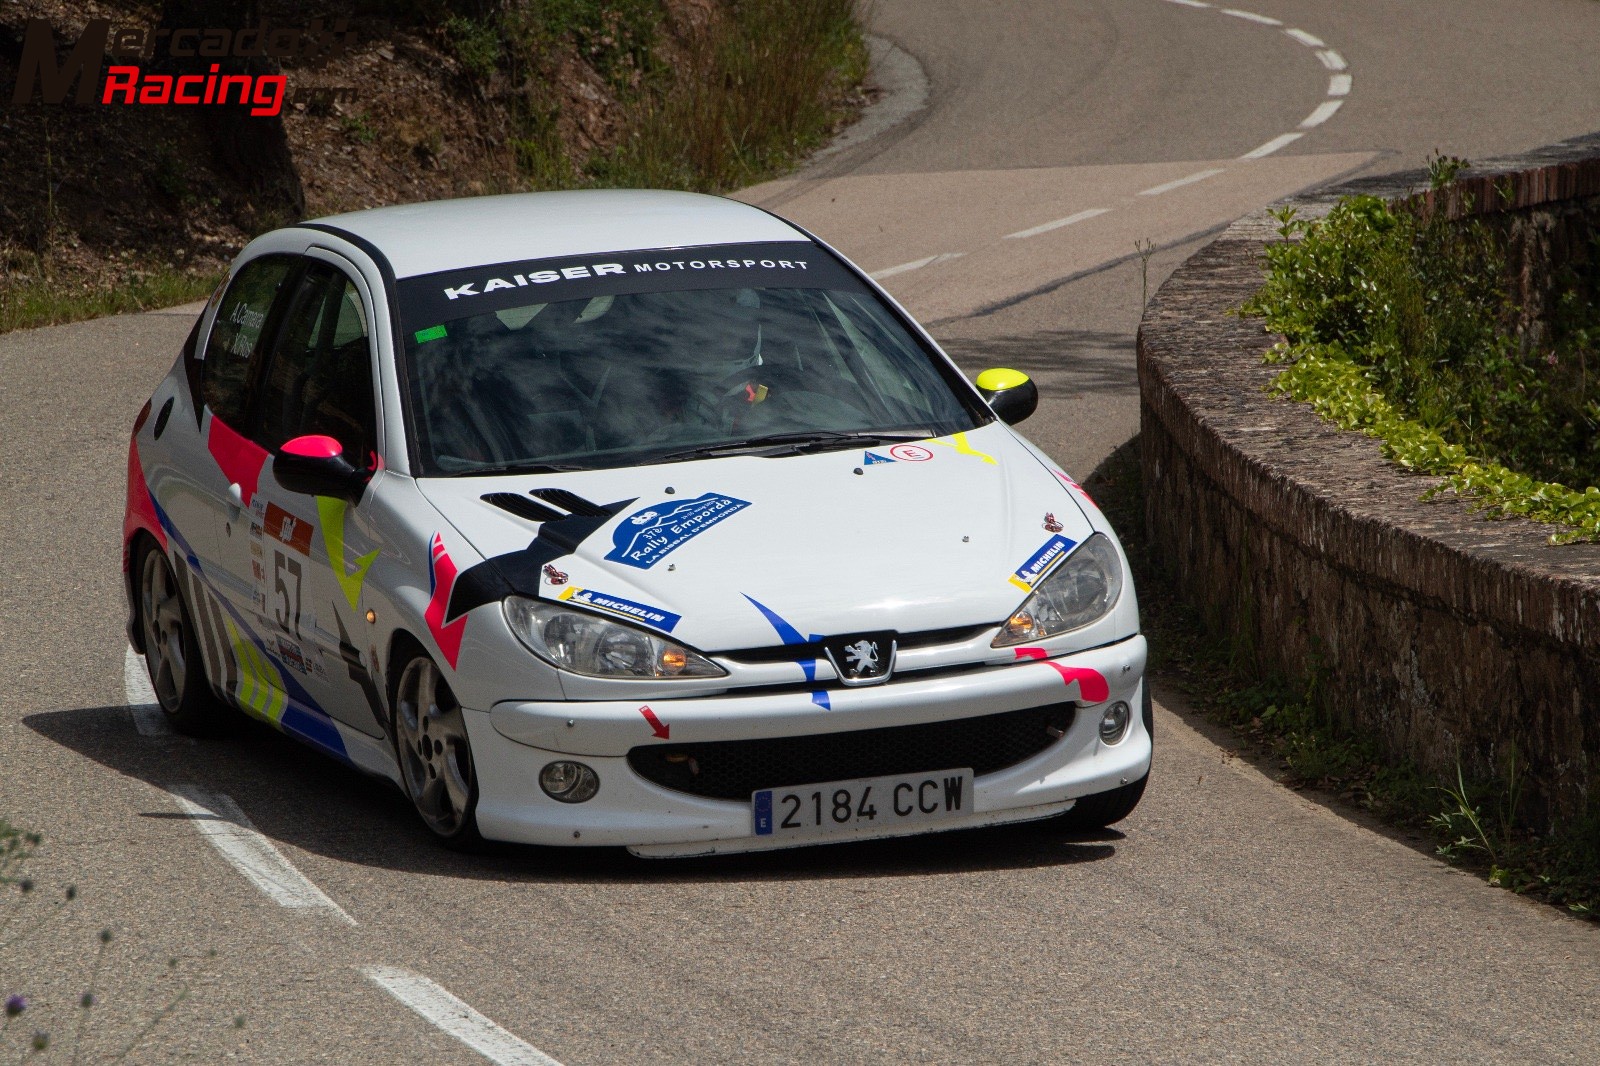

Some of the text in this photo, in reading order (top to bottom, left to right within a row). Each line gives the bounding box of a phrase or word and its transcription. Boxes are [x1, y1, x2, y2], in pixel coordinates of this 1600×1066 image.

[443, 259, 809, 300] KAISER MOTORSPORT
[630, 535, 668, 561] Rally
[645, 554, 660, 564] LA
[658, 533, 693, 555] BISBAL
[1030, 540, 1066, 573] MICHELIN
[274, 549, 302, 641] 57
[593, 597, 666, 622] MICHELIN
[760, 776, 963, 829] E 2184 CCW
